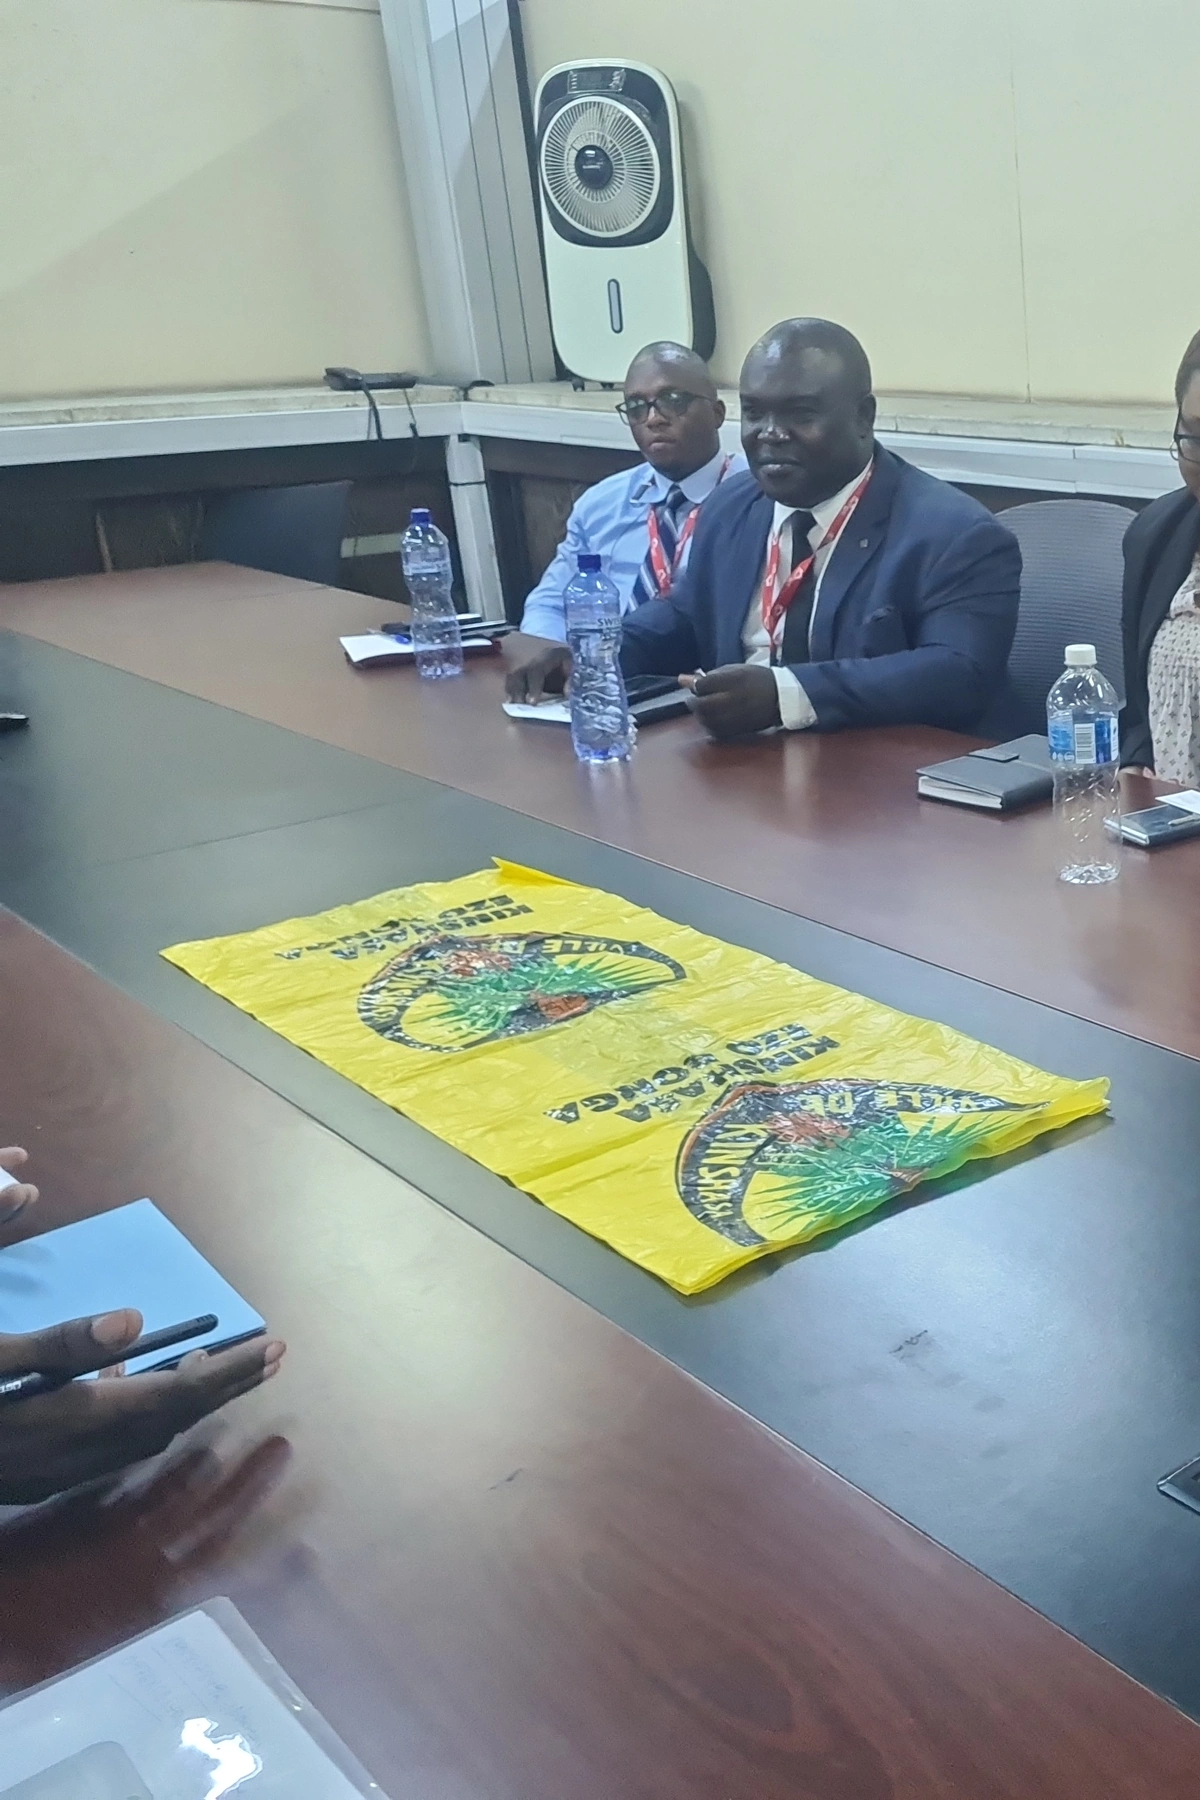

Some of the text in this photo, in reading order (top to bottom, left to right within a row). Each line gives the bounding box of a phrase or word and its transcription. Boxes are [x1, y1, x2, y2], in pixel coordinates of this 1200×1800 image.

[542, 937, 624, 956] VILLE
[614, 1035, 840, 1124] KINSHASA
[797, 1090, 854, 1114] DE
[873, 1089, 977, 1112] VILLE
